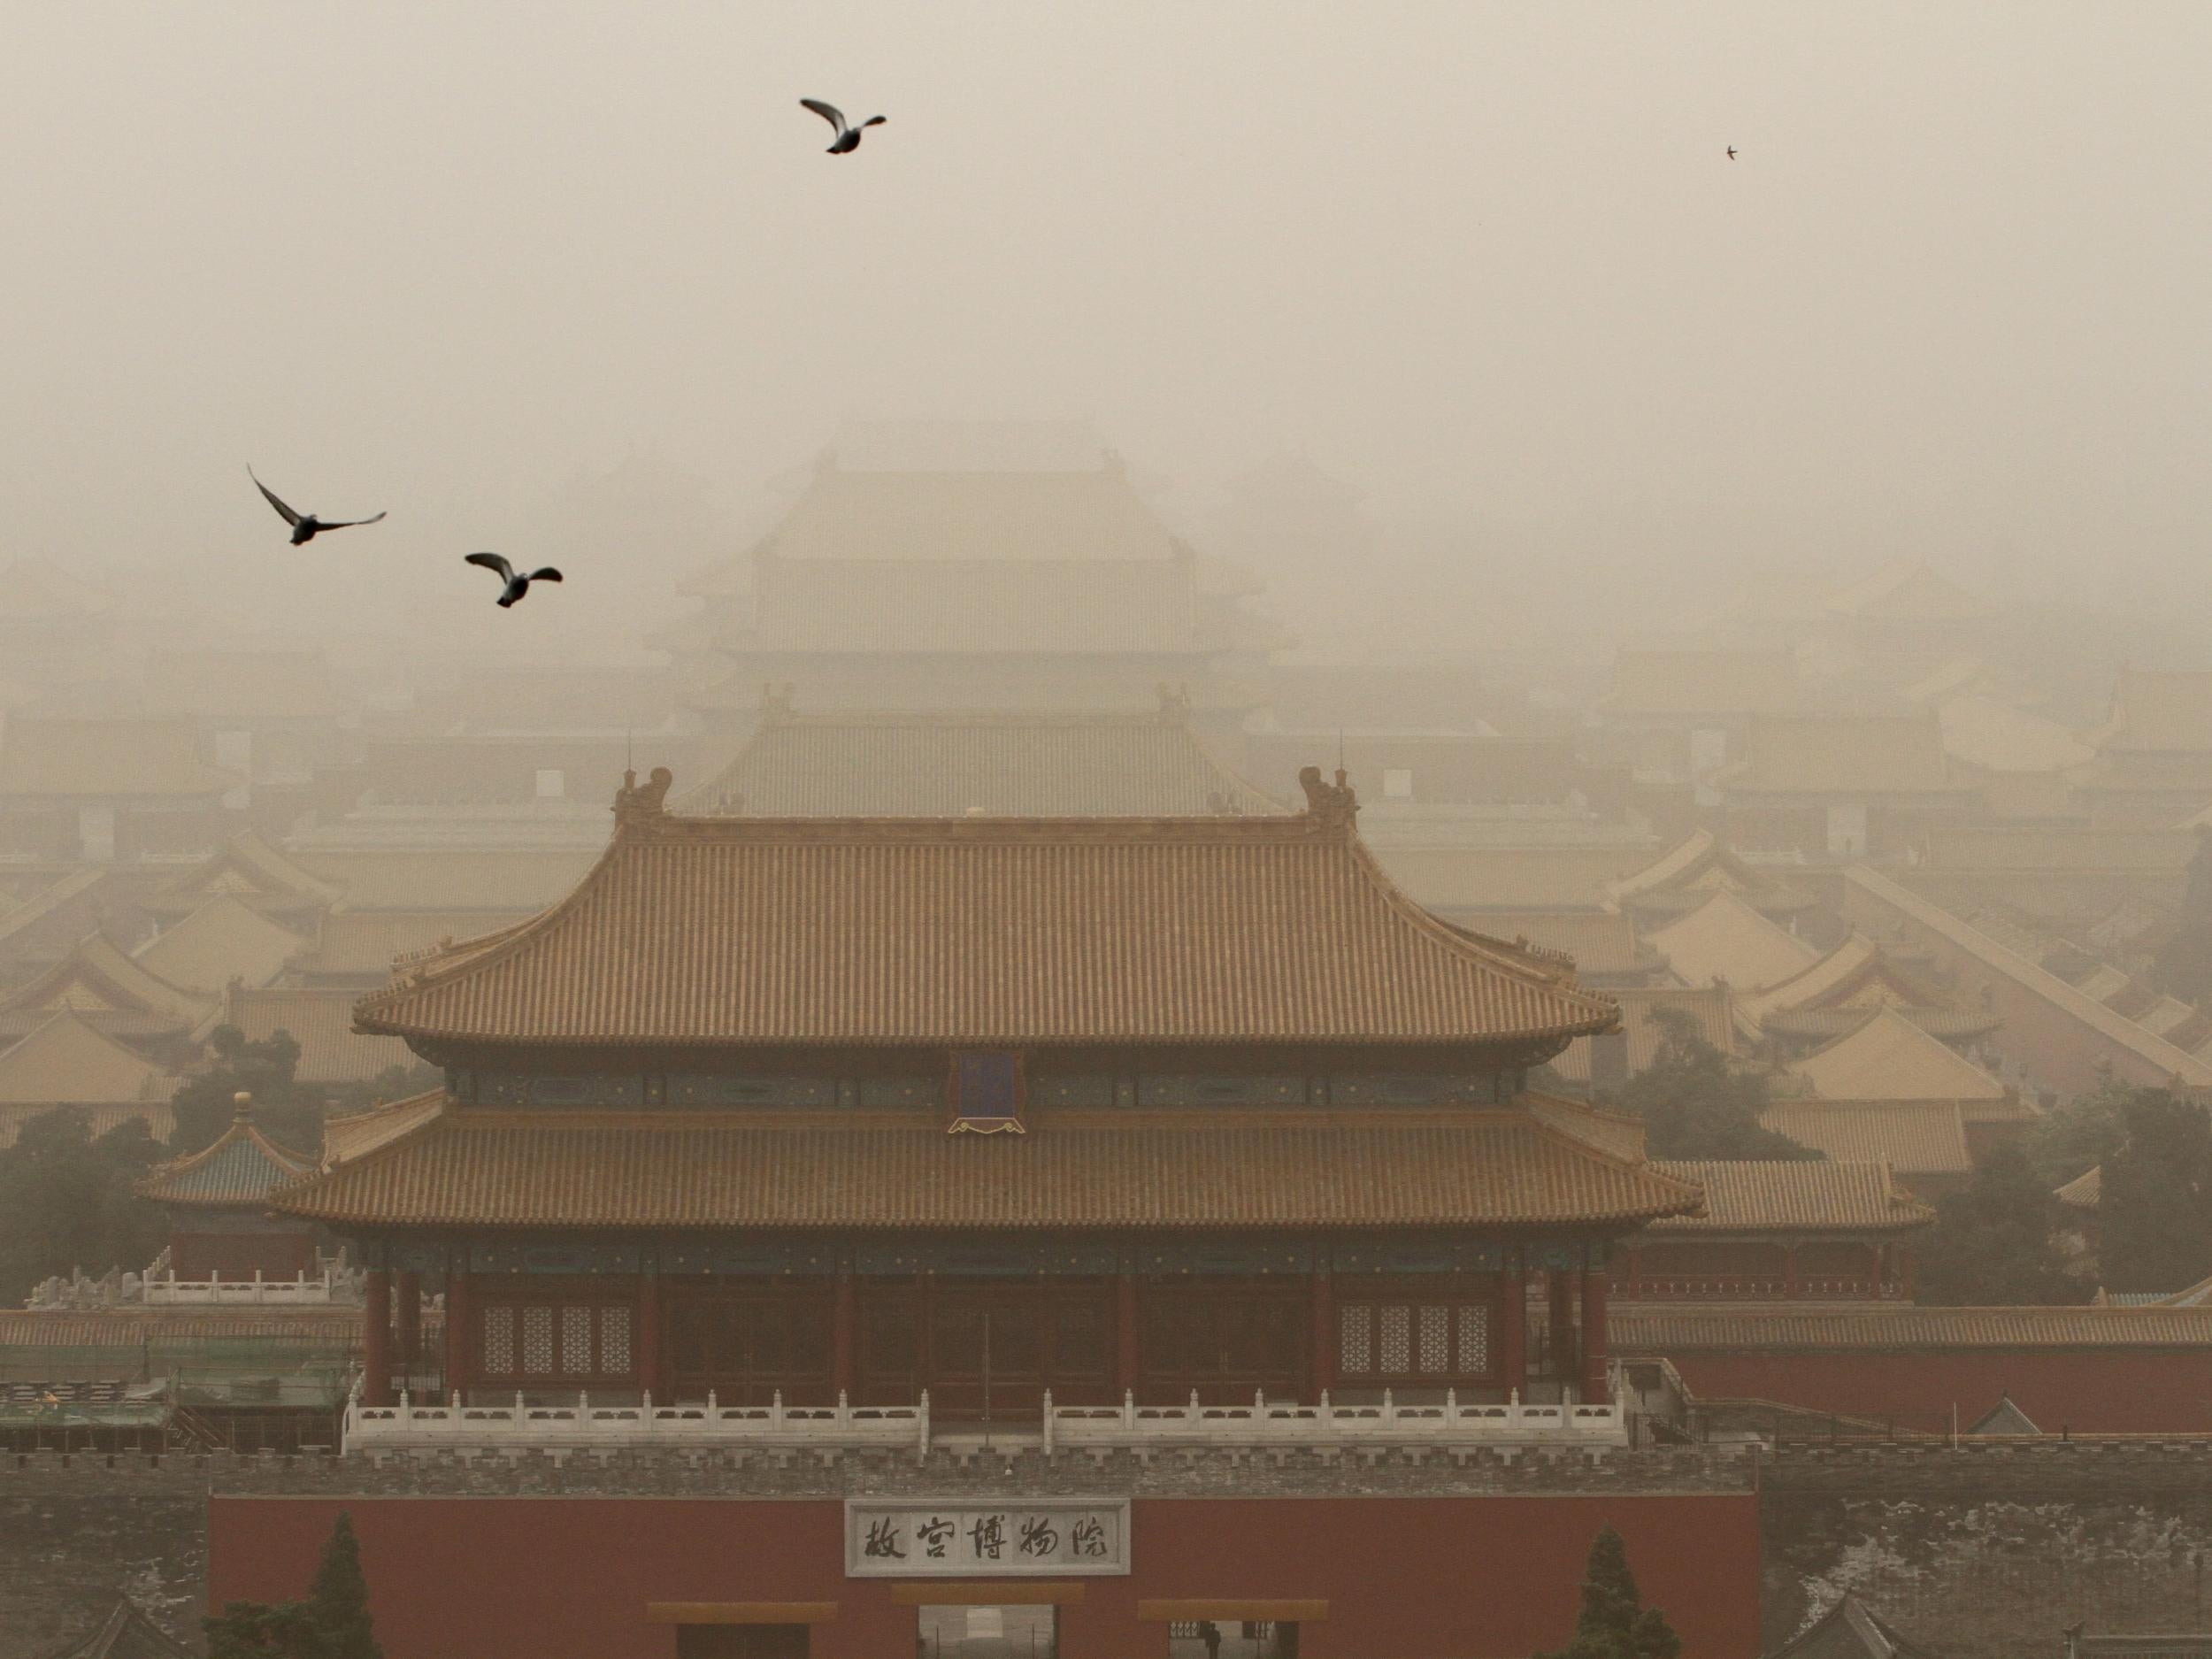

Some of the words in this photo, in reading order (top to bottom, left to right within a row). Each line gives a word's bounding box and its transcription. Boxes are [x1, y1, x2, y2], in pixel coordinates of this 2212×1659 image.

[864, 1515, 1108, 1560] 故宫博物院
